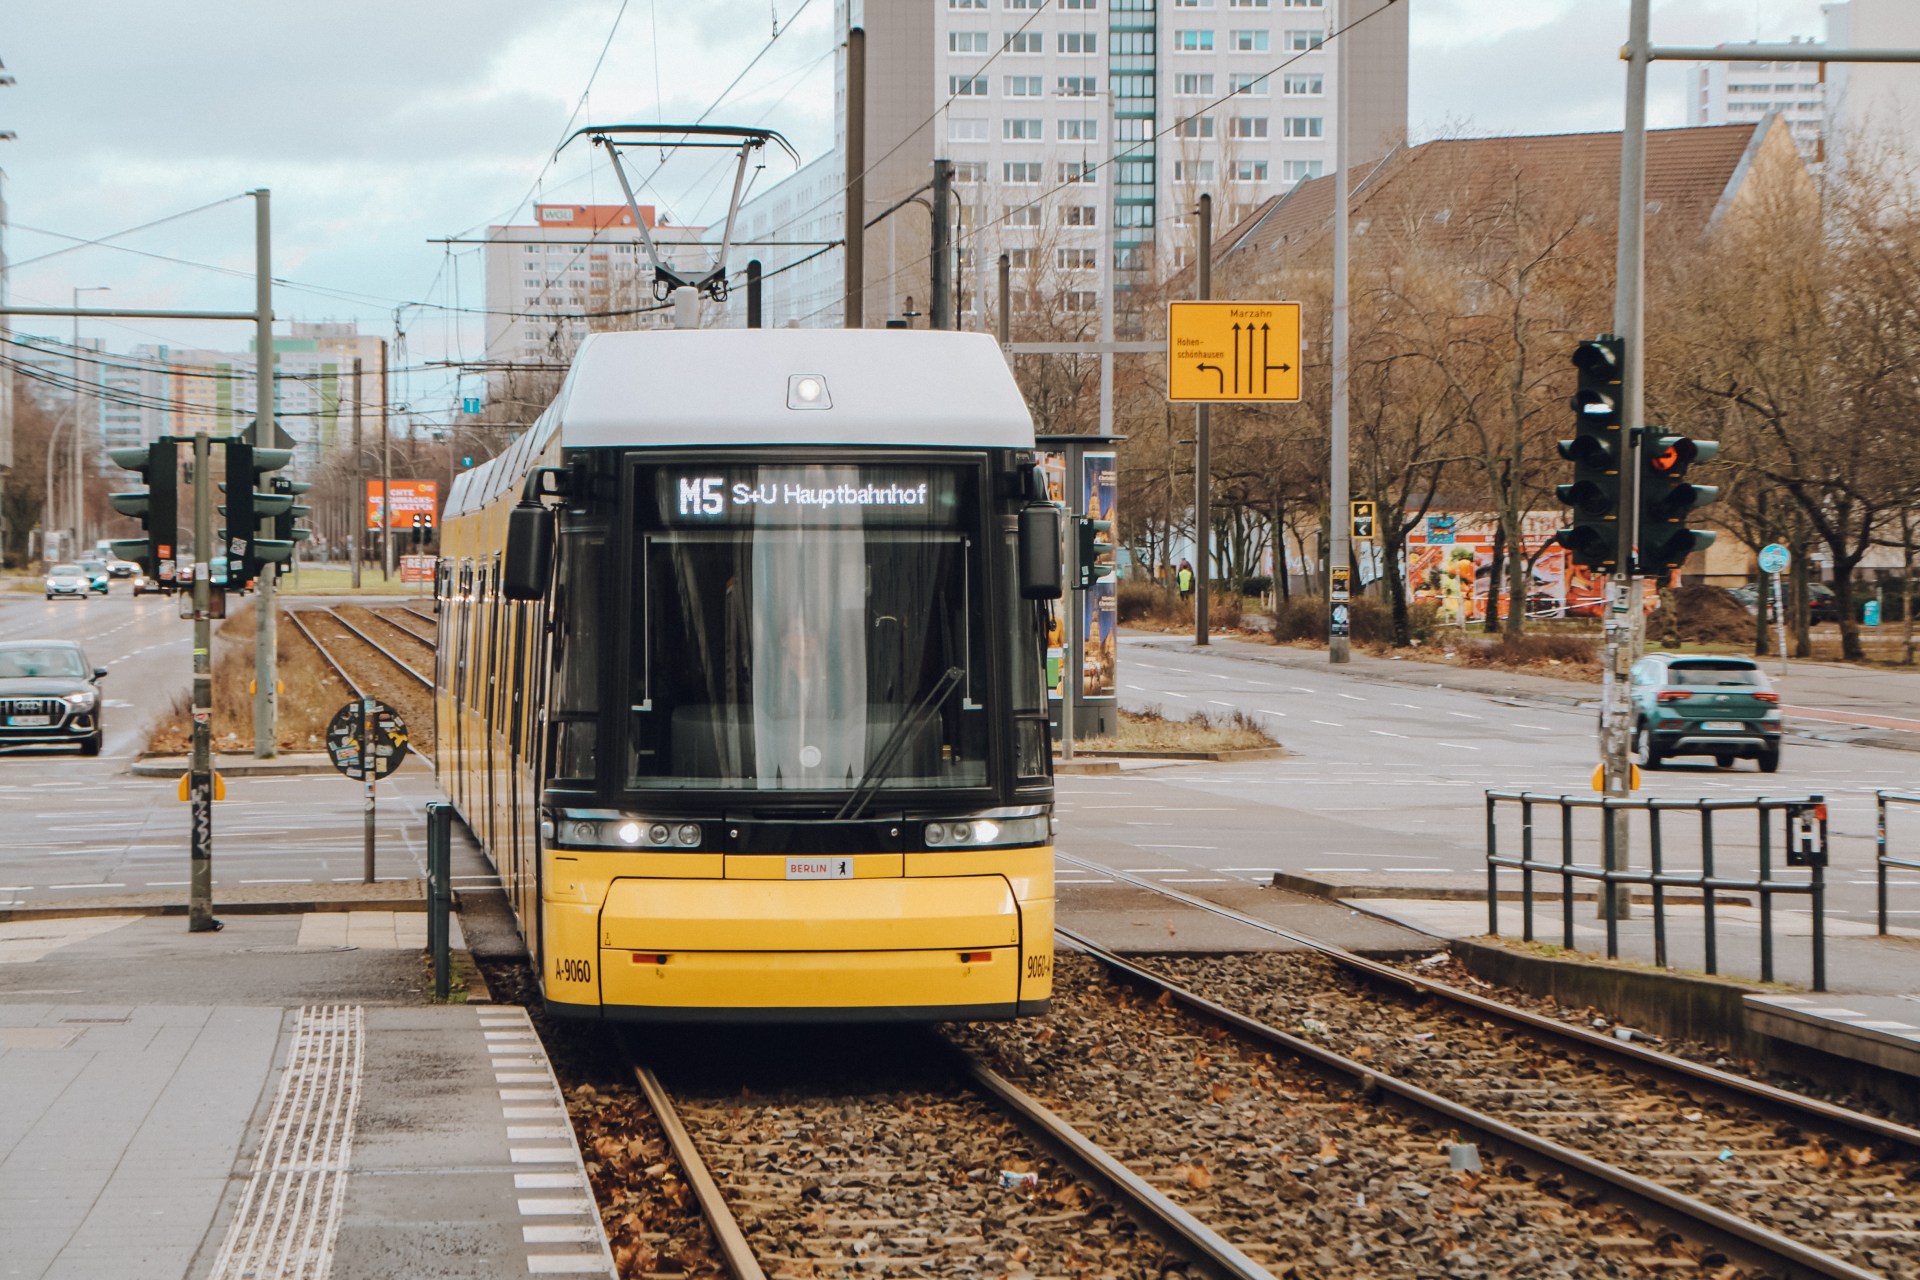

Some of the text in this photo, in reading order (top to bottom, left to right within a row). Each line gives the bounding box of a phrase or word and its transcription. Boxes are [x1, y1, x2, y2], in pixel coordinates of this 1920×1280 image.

[1230, 309, 1272, 318] Marzahn
[1177, 338, 1204, 346] Hohen-
[1177, 351, 1224, 359] schönhausen
[679, 478, 927, 515] M5 S+U Hauptbahnhof
[1792, 817, 1821, 853] H
[790, 864, 827, 873] BERLIN
[555, 958, 591, 983] A-9060
